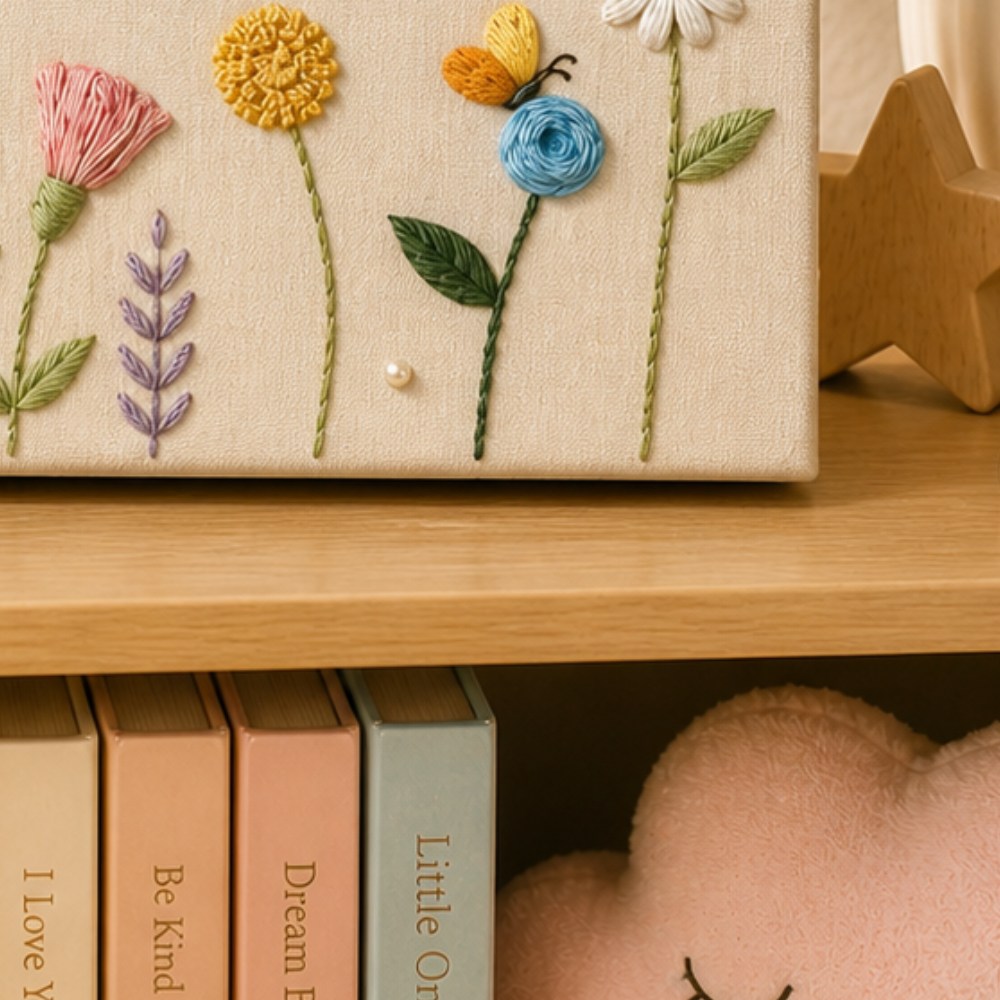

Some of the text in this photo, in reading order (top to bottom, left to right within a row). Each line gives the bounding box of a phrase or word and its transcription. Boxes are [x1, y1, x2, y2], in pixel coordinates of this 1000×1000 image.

[23, 868, 54, 882] I
[283, 861, 317, 975] Dream
[415, 834, 452, 936] Little
[23, 894, 54, 971] Love
[153, 864, 185, 995] Be Kind
